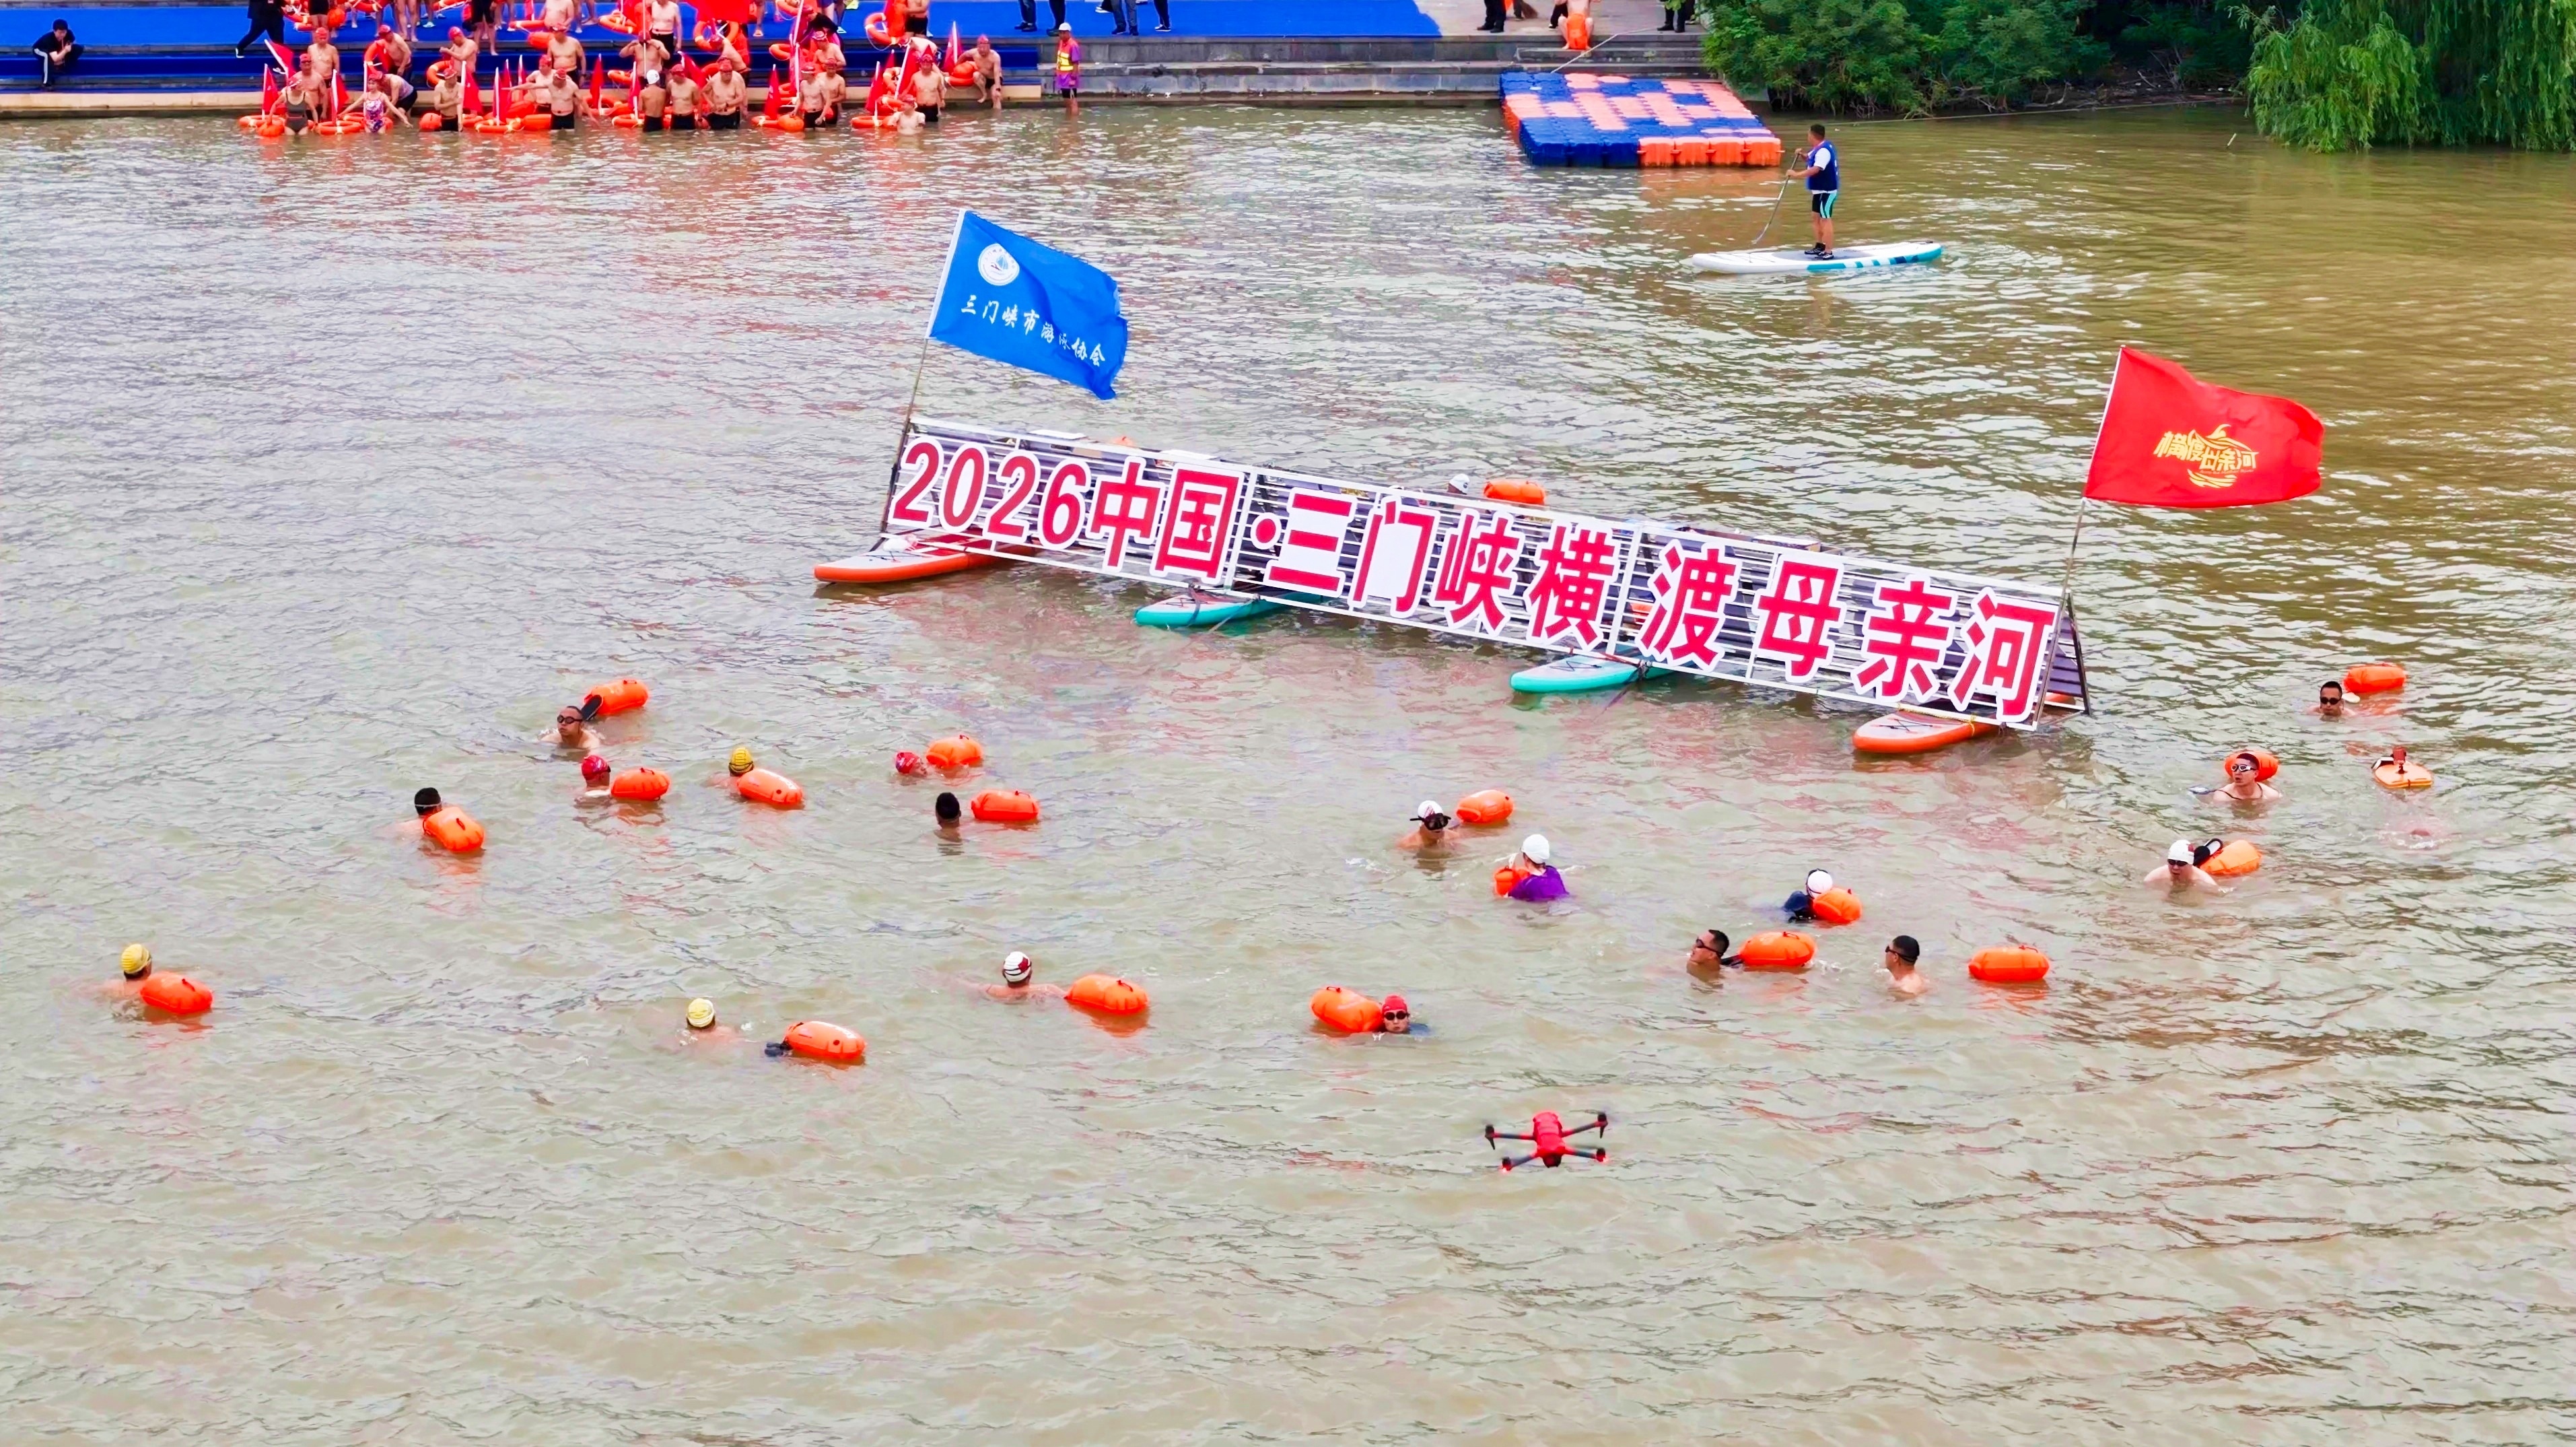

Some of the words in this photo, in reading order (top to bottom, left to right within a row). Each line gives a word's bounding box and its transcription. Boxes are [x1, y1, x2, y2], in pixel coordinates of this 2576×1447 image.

[961, 294, 1106, 367] 三门峡市游泳协会
